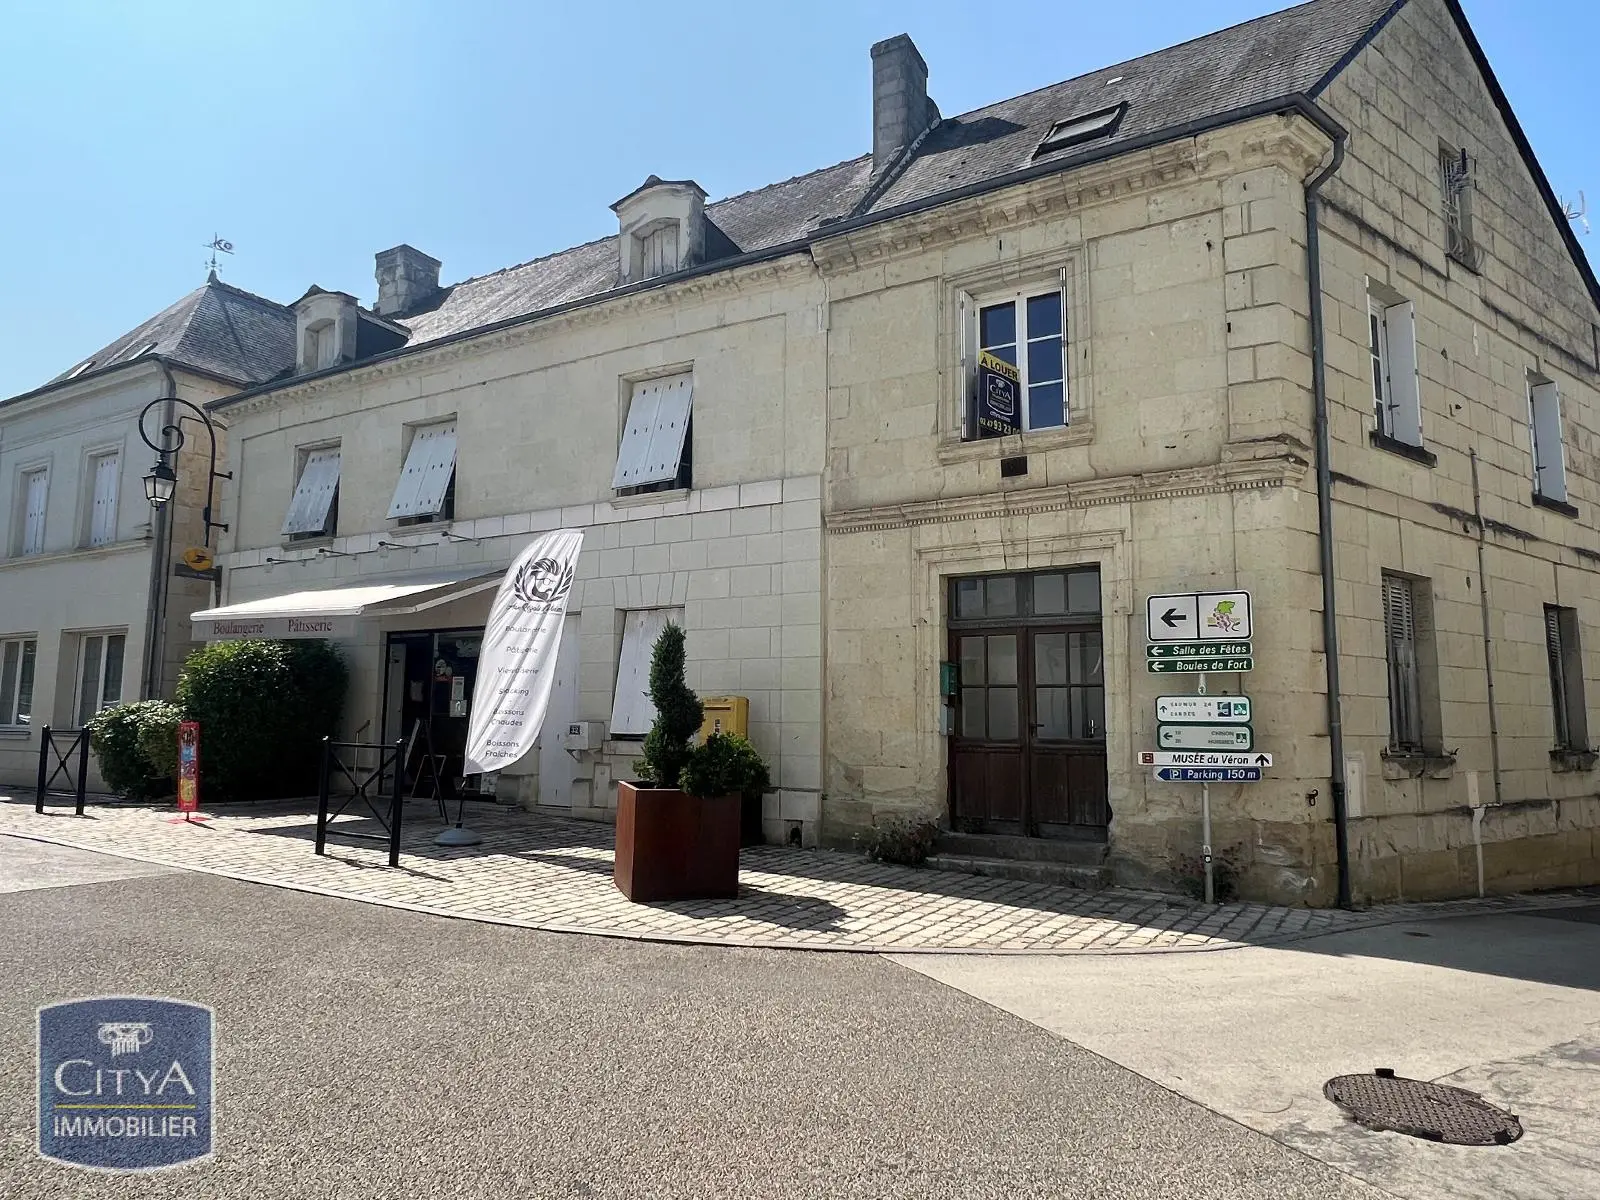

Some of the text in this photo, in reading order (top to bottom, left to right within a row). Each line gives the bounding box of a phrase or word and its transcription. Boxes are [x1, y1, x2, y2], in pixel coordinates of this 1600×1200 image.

[990, 360, 1018, 381] LOUER
[993, 420, 1002, 432] 93
[1003, 424, 1012, 435] 23
[213, 619, 333, 637] Boulangerie Pâtisserie
[1172, 644, 1247, 655] Salle des Fêtes
[1176, 660, 1247, 671] Boules de Fort
[486, 740, 520, 748] Boissons
[1171, 752, 1249, 765] MUSÉE du Véron
[1187, 769, 1223, 780] Parking
[1226, 770, 1246, 779] 150
[1247, 771, 1257, 779] m
